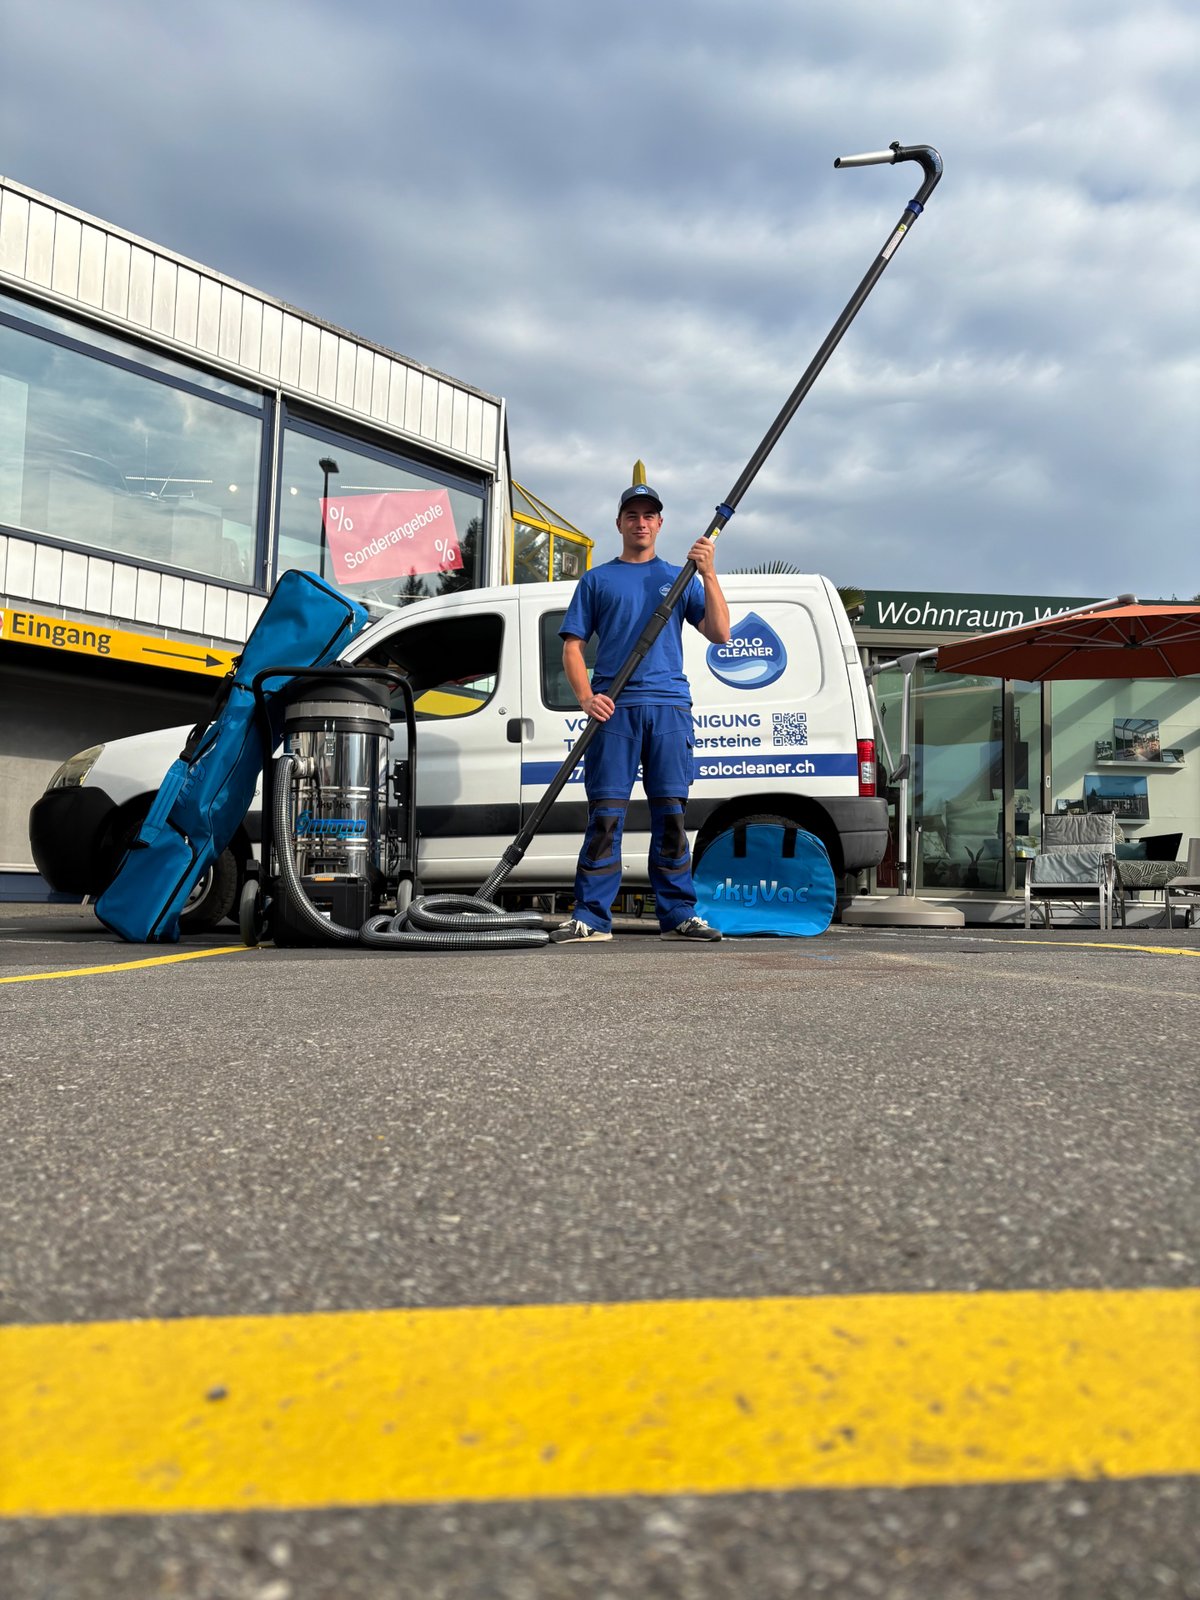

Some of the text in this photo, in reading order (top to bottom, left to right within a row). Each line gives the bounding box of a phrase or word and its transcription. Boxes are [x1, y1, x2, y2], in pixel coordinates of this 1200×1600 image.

[344, 504, 444, 569] Sonderangebote
[877, 601, 1024, 628] Wohnraum
[12, 612, 111, 654] Eingang
[726, 637, 763, 648] SOLO
[717, 647, 774, 658] CLEANER
[692, 714, 761, 728] NIGUNG
[694, 734, 761, 748] ersteine
[699, 759, 815, 776] solocleaner.ch
